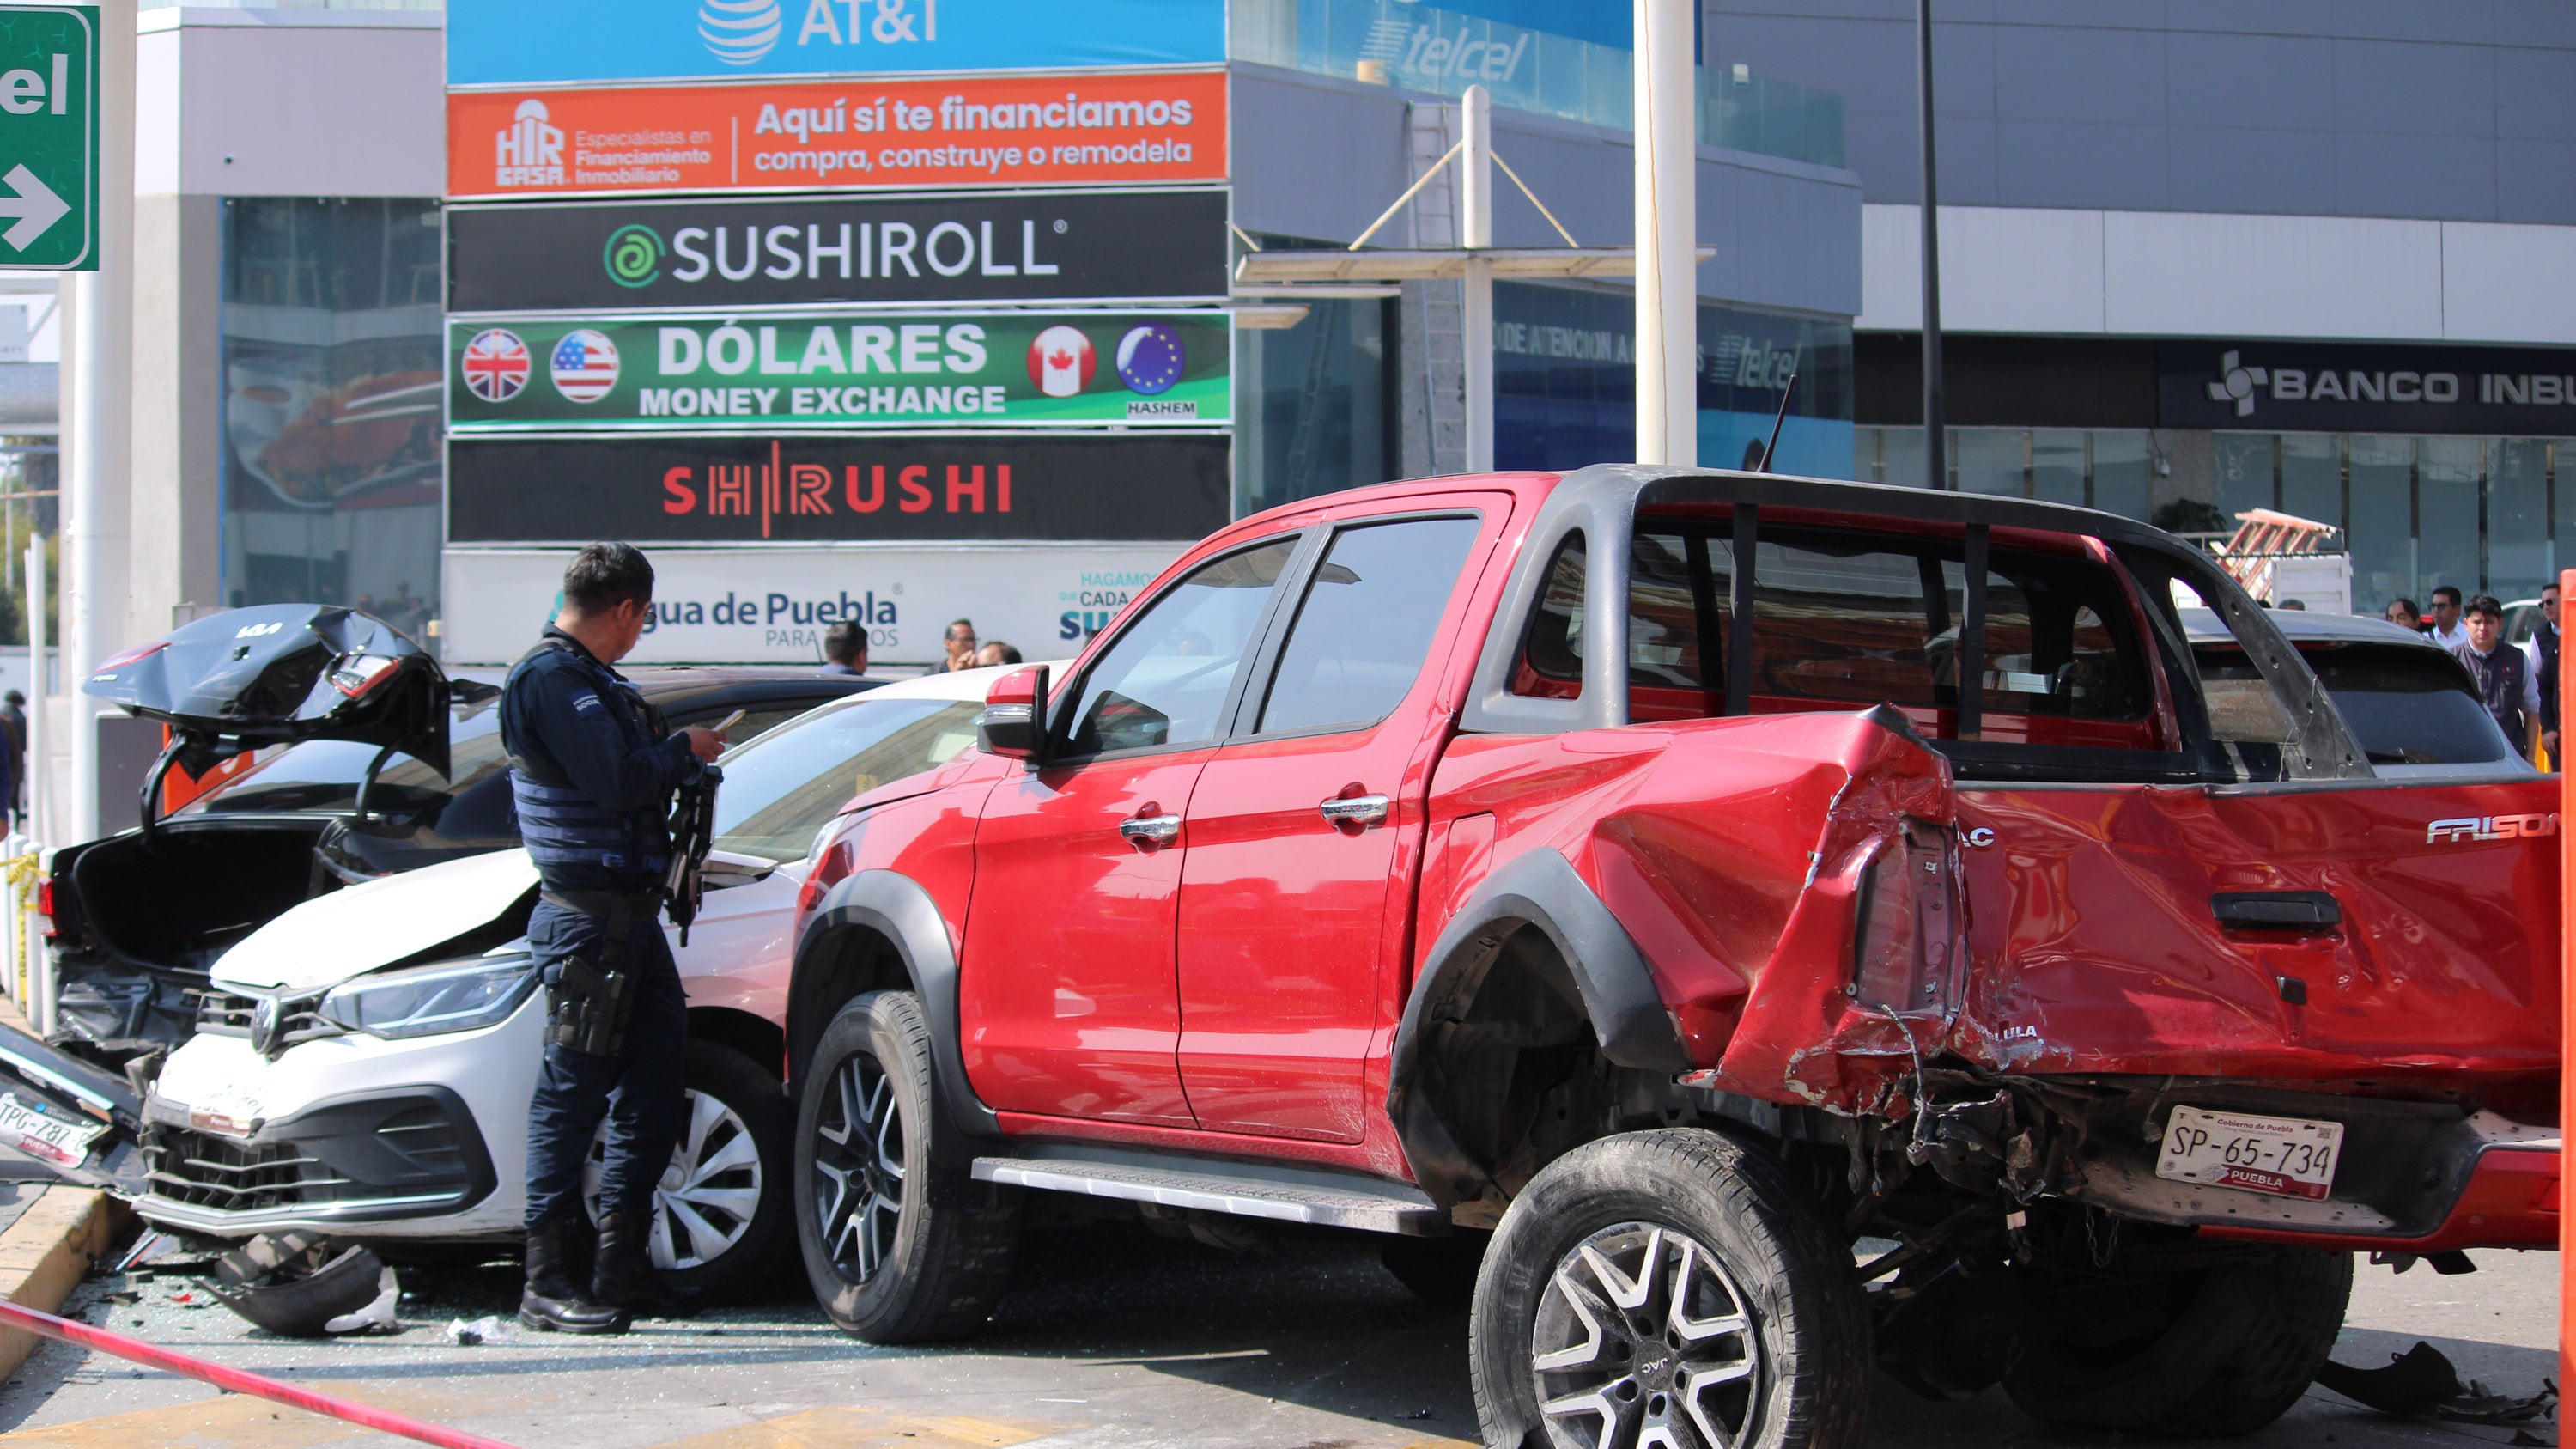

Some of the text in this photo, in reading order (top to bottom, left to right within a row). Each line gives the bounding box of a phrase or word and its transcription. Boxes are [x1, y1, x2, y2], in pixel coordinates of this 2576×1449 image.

[798, 0, 936, 45] AT&T
[1402, 24, 1528, 82] telcel
[755, 94, 1193, 144] Aquí sí te financiamos
[575, 130, 711, 149] Especialistas en
[575, 148, 712, 167] Financiamiento
[754, 138, 1192, 178] compra, construye o remodela
[575, 167, 681, 185] Inmobiliario
[658, 318, 987, 375] DÓLARES
[1504, 322, 1526, 354] DE
[639, 385, 1005, 417] MONEY EXCHANGE
[2271, 368, 2459, 404] BANCO
[1127, 401, 1196, 416] HASHEM
[712, 591, 757, 625] de
[767, 590, 897, 625] Puebla
[1080, 591, 1129, 606] CADA
[766, 629, 817, 647] PARA
[2217, 1118, 2253, 1129] Gobierno
[2266, 1123, 2293, 1133] Puebla
[2170, 1126, 2330, 1178] SP-65-734
[2231, 1170, 2284, 1188] PUEBLA
[1641, 1357, 1668, 1373] JAC
